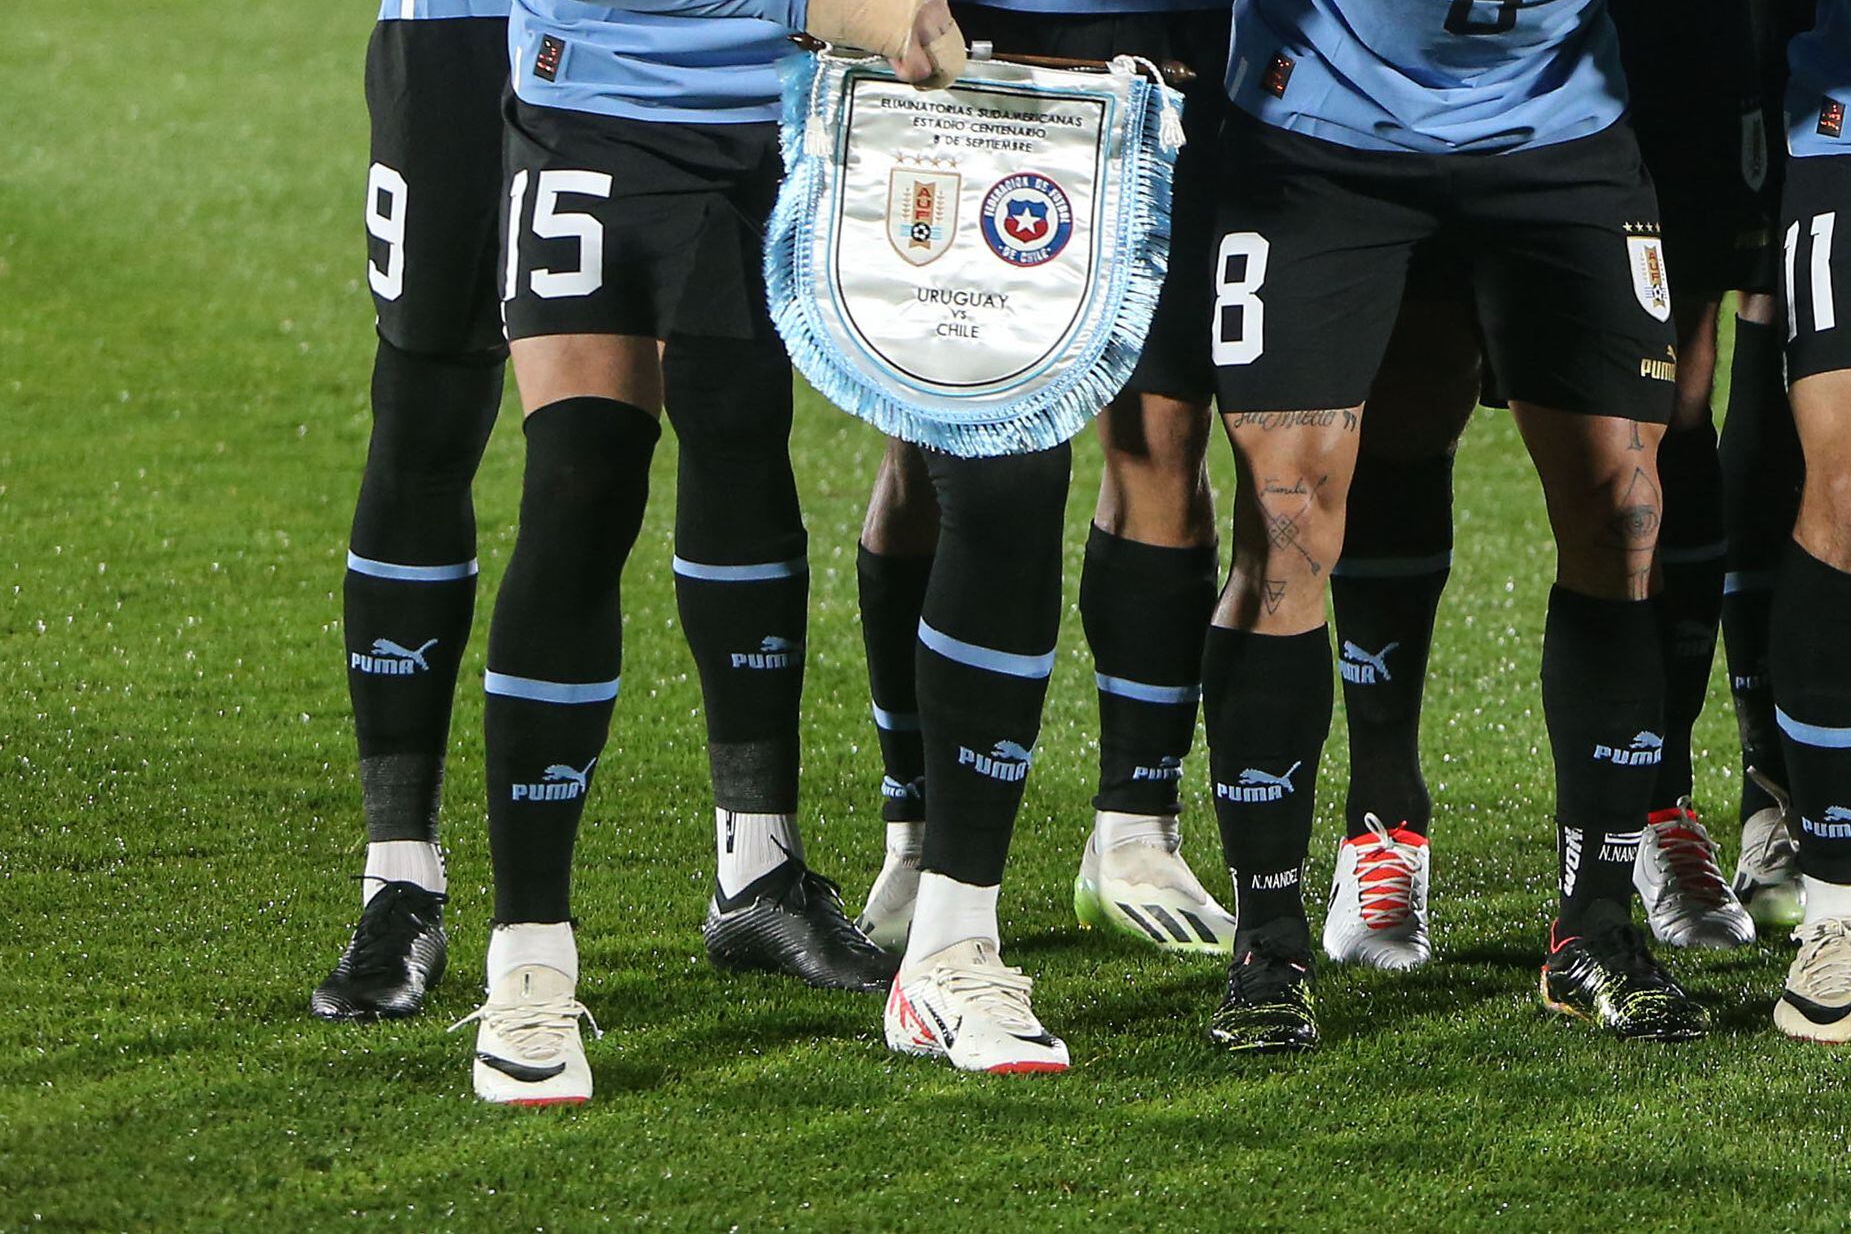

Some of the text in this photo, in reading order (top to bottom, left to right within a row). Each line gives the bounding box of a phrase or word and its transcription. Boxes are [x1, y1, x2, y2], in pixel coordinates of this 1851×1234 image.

[881, 97, 1083, 127] ELIMINATORIAS SUDAMERICANAS
[912, 116, 1047, 139] ESTADIO CENTENARIO
[945, 135, 961, 146] DE
[966, 136, 1033, 153] SEPTIEMBRE
[915, 187, 931, 220] AUF
[366, 163, 409, 302] 9
[504, 168, 613, 302] 15
[1783, 212, 1837, 343] 11
[917, 287, 1009, 309] URUGUAY
[1212, 232, 1271, 366] 8
[936, 322, 980, 339] CHILE
[350, 652, 415, 675] PUMA
[731, 653, 789, 670] PUM
[959, 746, 1027, 782] PUMA
[511, 783, 586, 802] PUMA
[1216, 782, 1283, 803] PUMA
